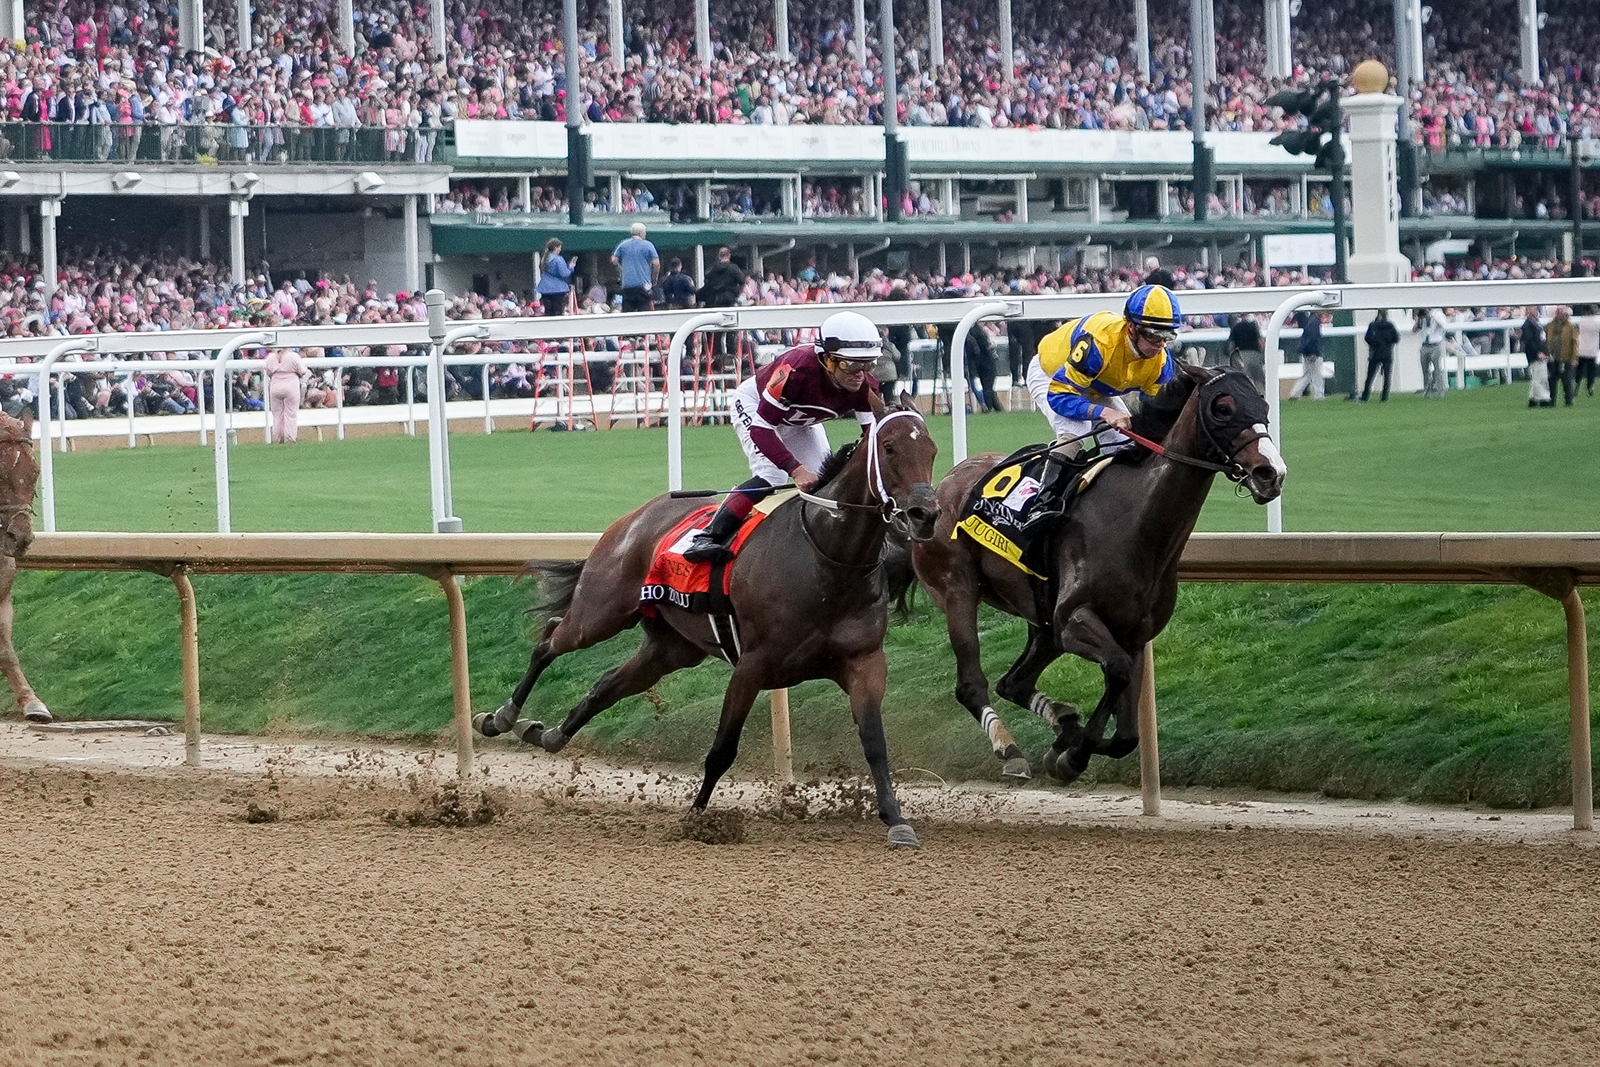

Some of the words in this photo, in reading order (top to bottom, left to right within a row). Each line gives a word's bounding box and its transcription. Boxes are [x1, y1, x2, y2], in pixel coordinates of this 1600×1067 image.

[910, 138, 949, 154] HURCHILL
[1072, 340, 1089, 363] 6
[640, 585, 664, 601] HO
